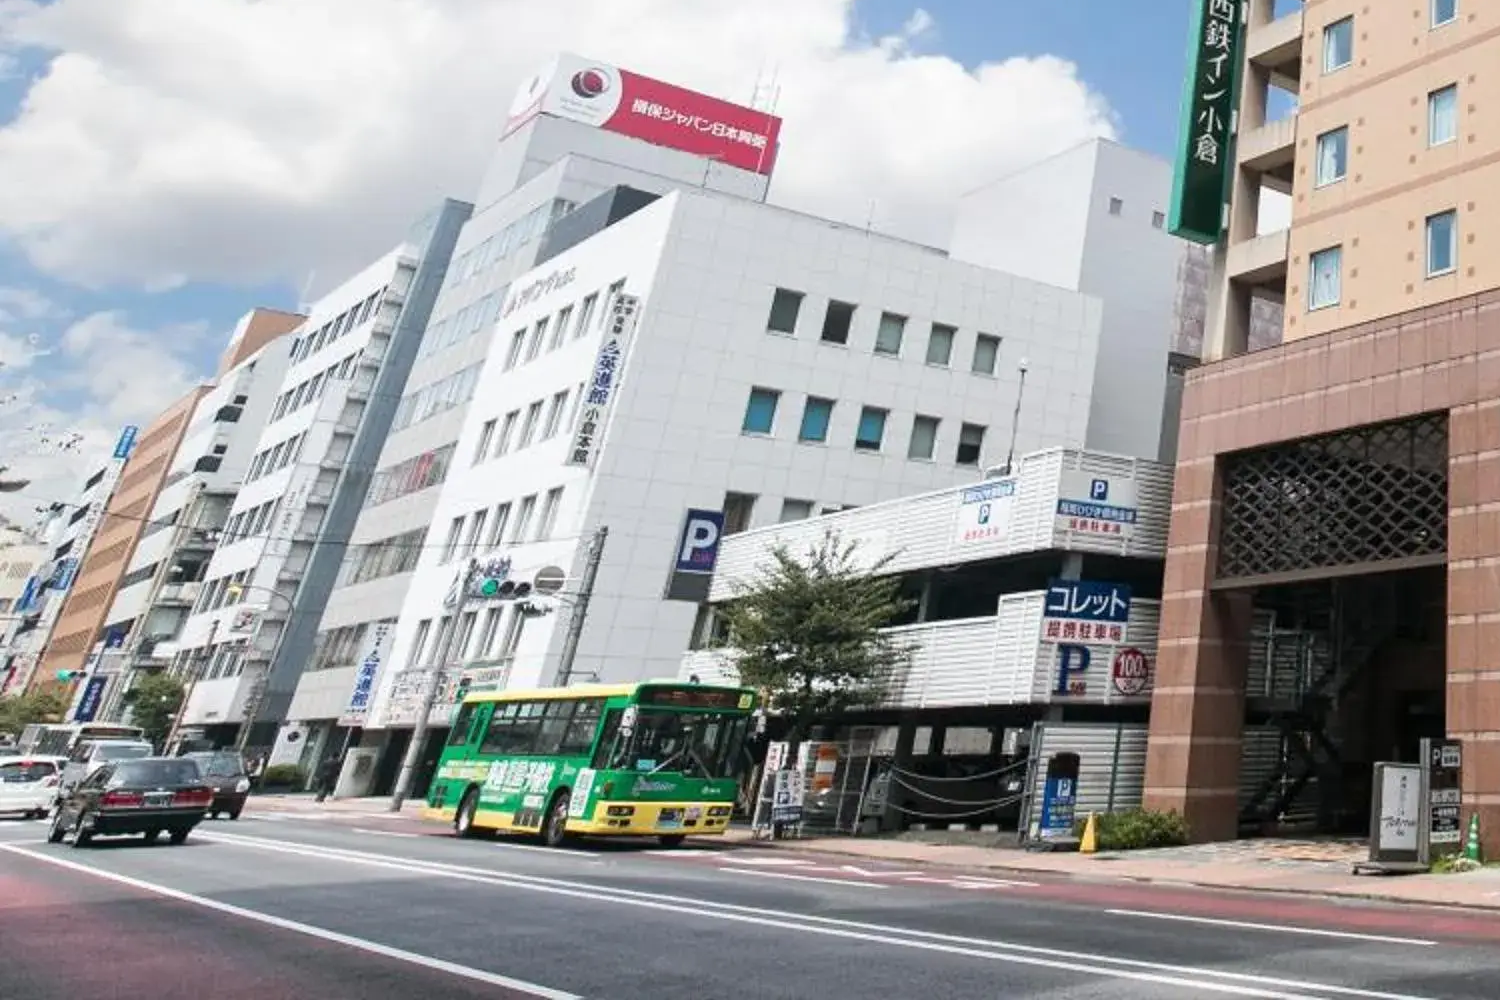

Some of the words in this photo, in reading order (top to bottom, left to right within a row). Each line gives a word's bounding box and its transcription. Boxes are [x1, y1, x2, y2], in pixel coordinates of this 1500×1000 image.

[1093, 482, 1106, 498] P
[681, 519, 718, 561] P
[1048, 587, 1127, 617] コレット
[1047, 620, 1122, 640] 提携駐車場
[1052, 644, 1091, 696] P
